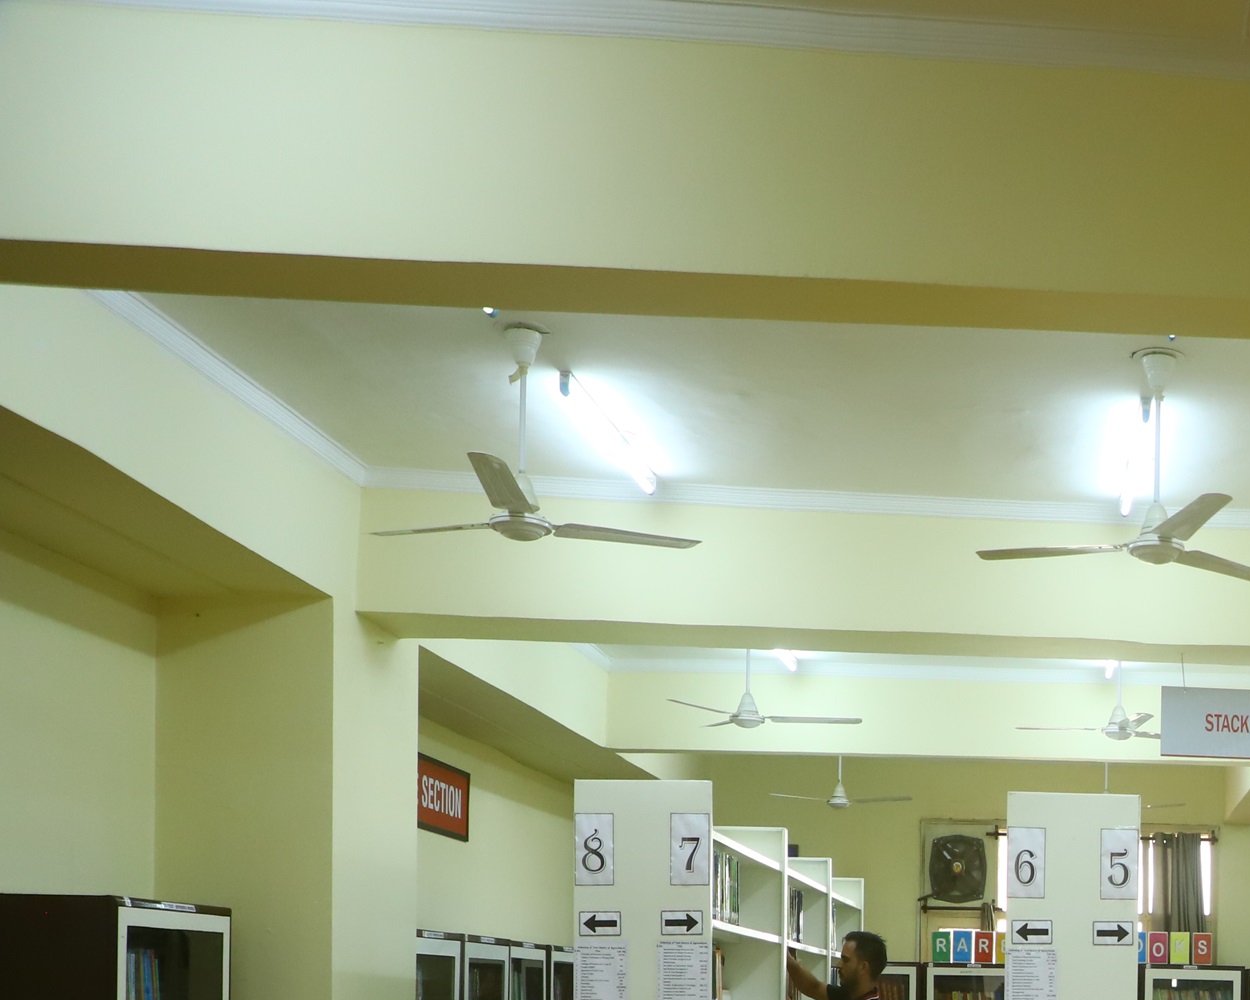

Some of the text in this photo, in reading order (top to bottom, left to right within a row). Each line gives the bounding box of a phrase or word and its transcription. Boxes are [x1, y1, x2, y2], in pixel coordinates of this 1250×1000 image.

[1204, 713, 1250, 734] STACK
[421, 774, 462, 819] SECTION
[581, 828, 607, 874] 8
[678, 837, 702, 873] 7
[1014, 849, 1037, 886] 6
[1107, 848, 1131, 888] 5
